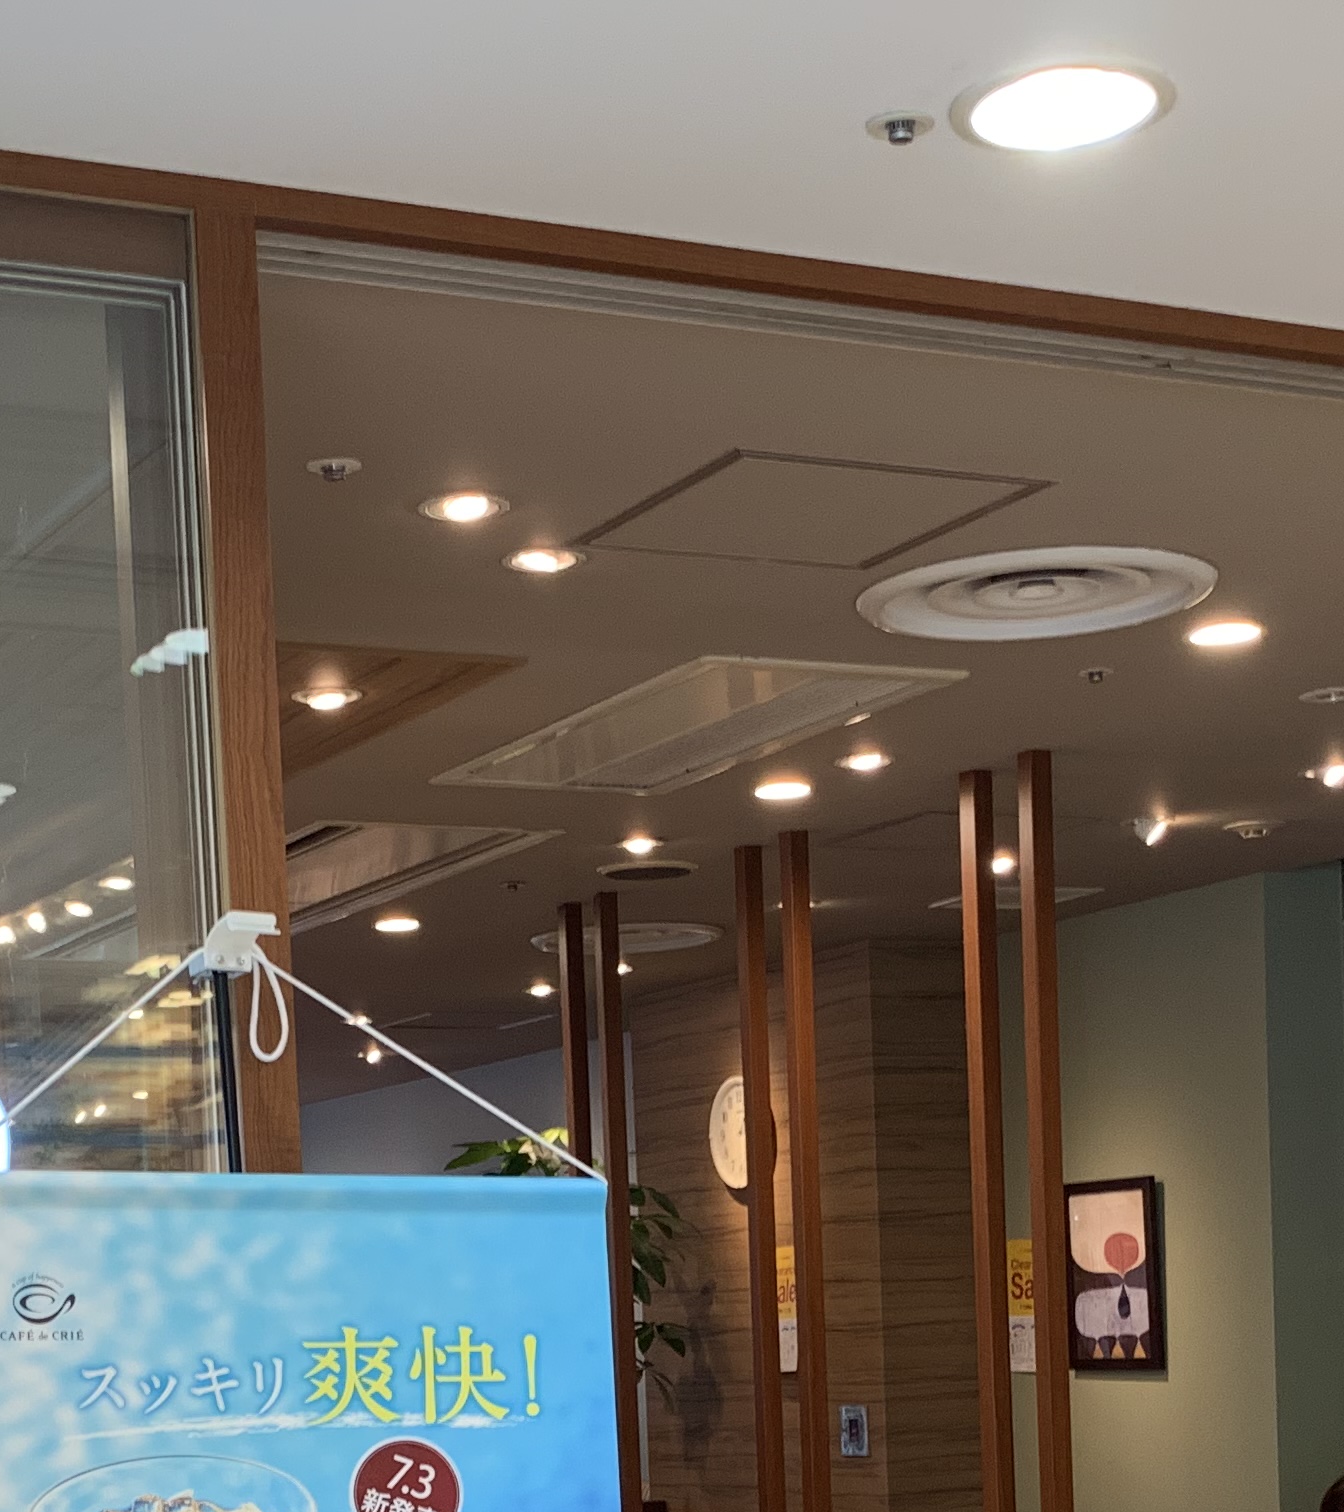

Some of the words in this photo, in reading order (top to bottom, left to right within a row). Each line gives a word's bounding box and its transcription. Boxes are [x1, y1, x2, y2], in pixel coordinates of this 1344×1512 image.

[0, 1328, 34, 1341] CAFÉ
[38, 1331, 48, 1341] de
[52, 1328, 85, 1341] CRIÉ
[386, 1453, 437, 1500] 7.3
